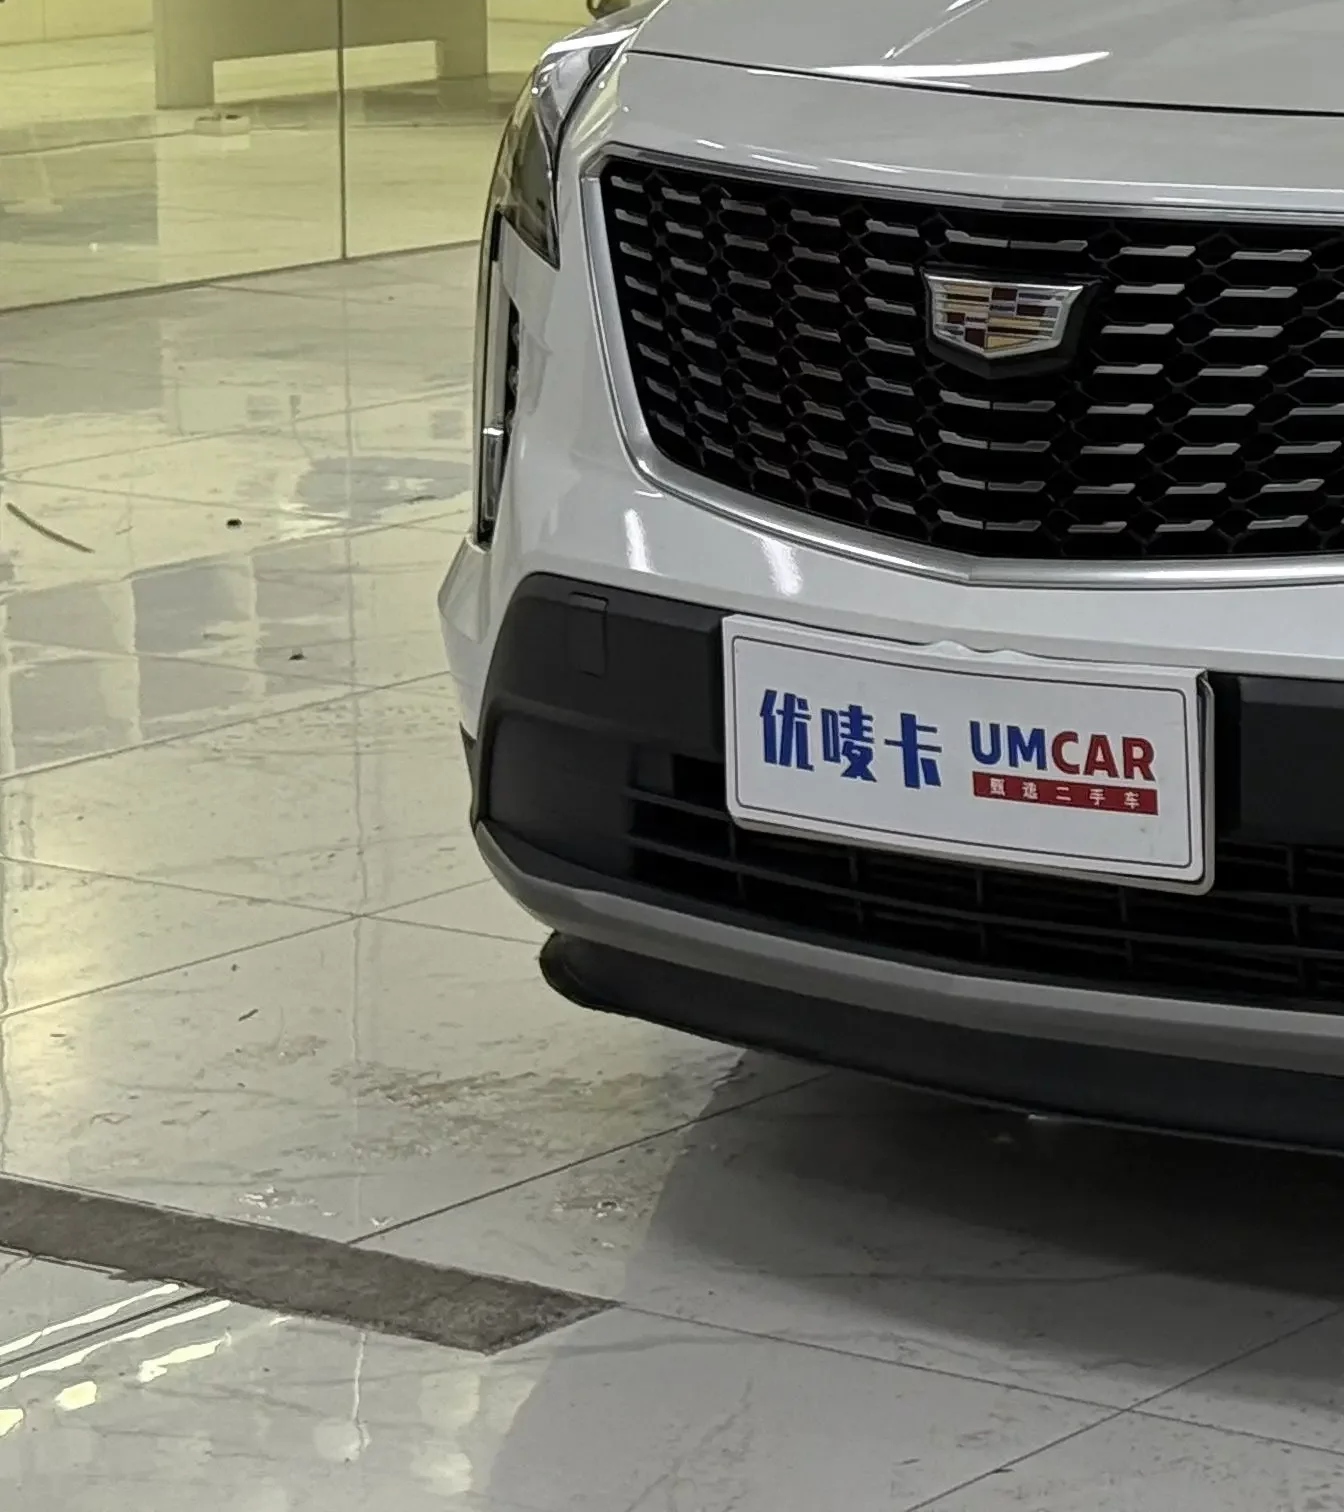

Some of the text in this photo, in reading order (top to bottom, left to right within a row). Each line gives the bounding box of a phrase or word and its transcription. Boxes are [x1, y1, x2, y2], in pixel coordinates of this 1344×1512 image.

[760, 689, 1156, 789] 优唛卡 UMCAR
